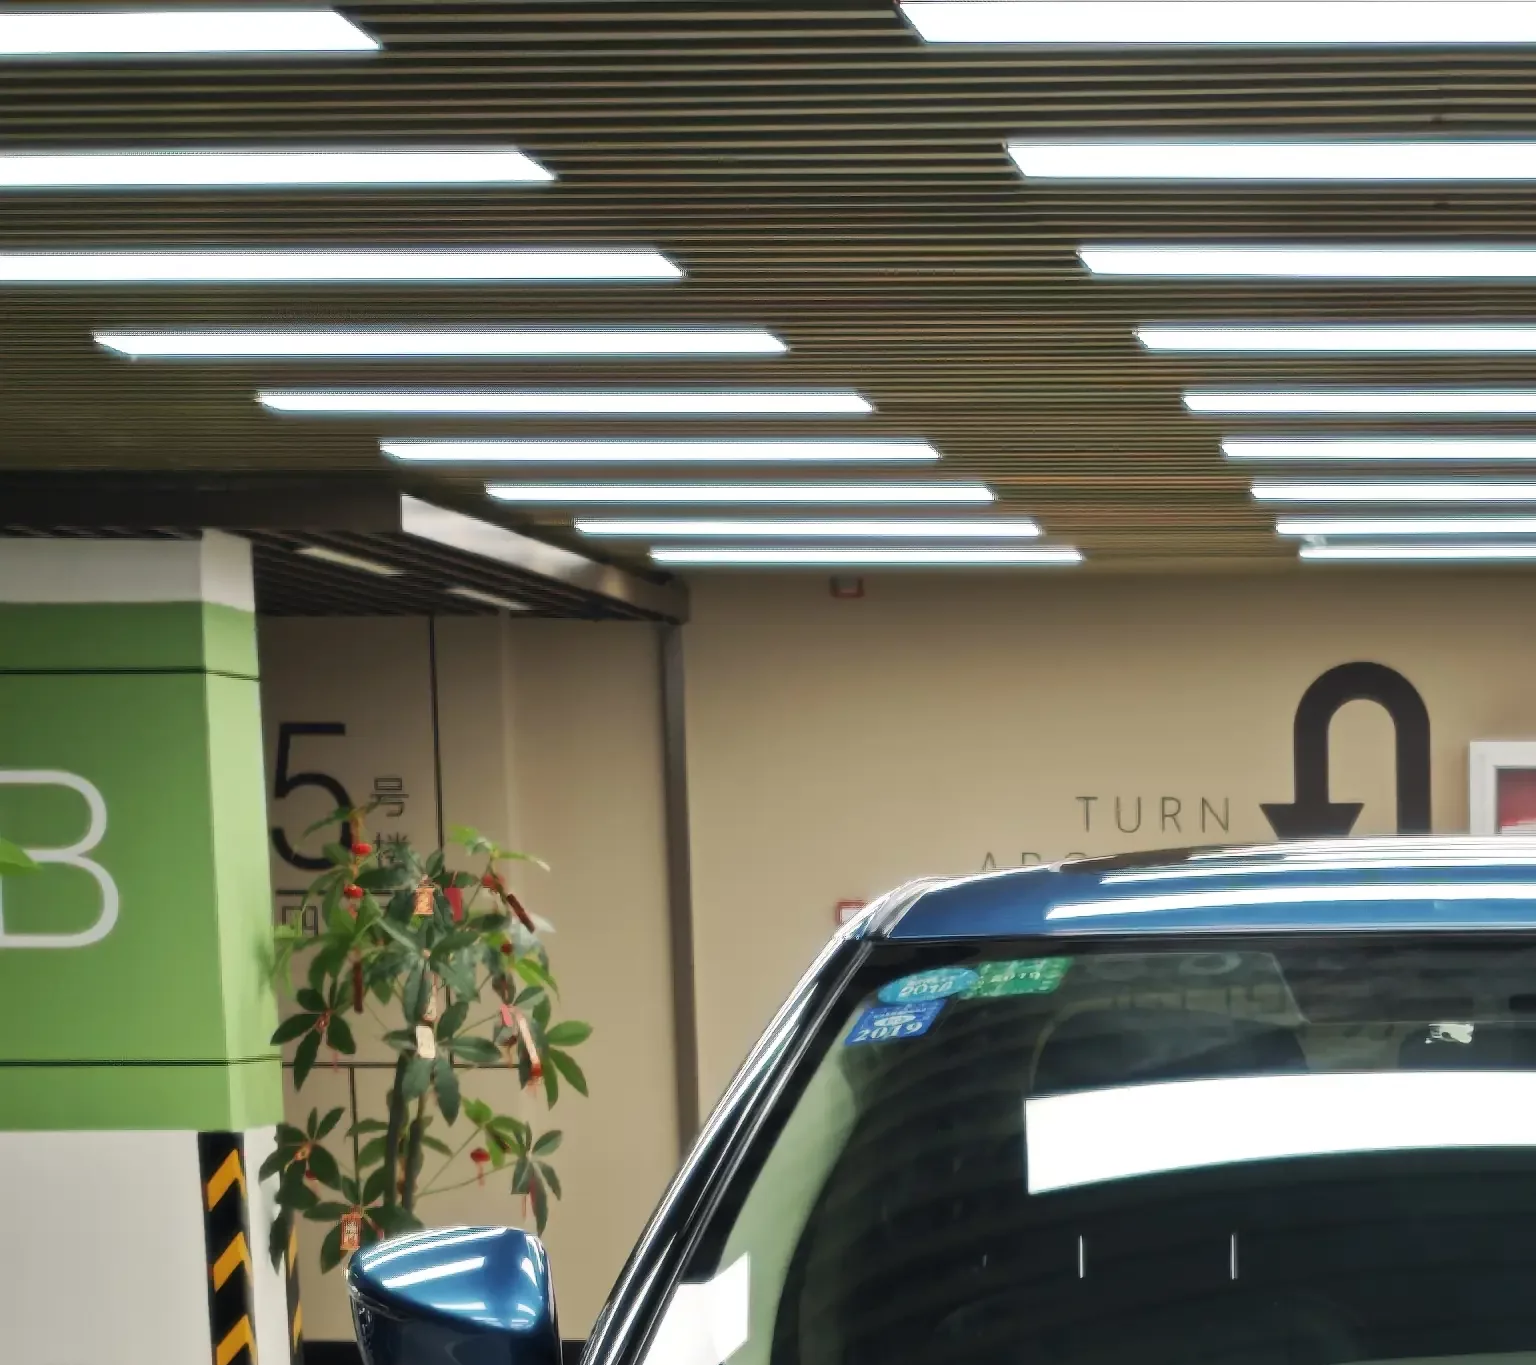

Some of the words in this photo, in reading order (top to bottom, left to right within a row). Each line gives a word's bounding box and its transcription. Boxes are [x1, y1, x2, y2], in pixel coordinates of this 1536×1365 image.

[272, 722, 354, 870] 5
[1074, 796, 1231, 834] TURN
[0, 770, 119, 948] B
[850, 1021, 924, 1043] 2019
